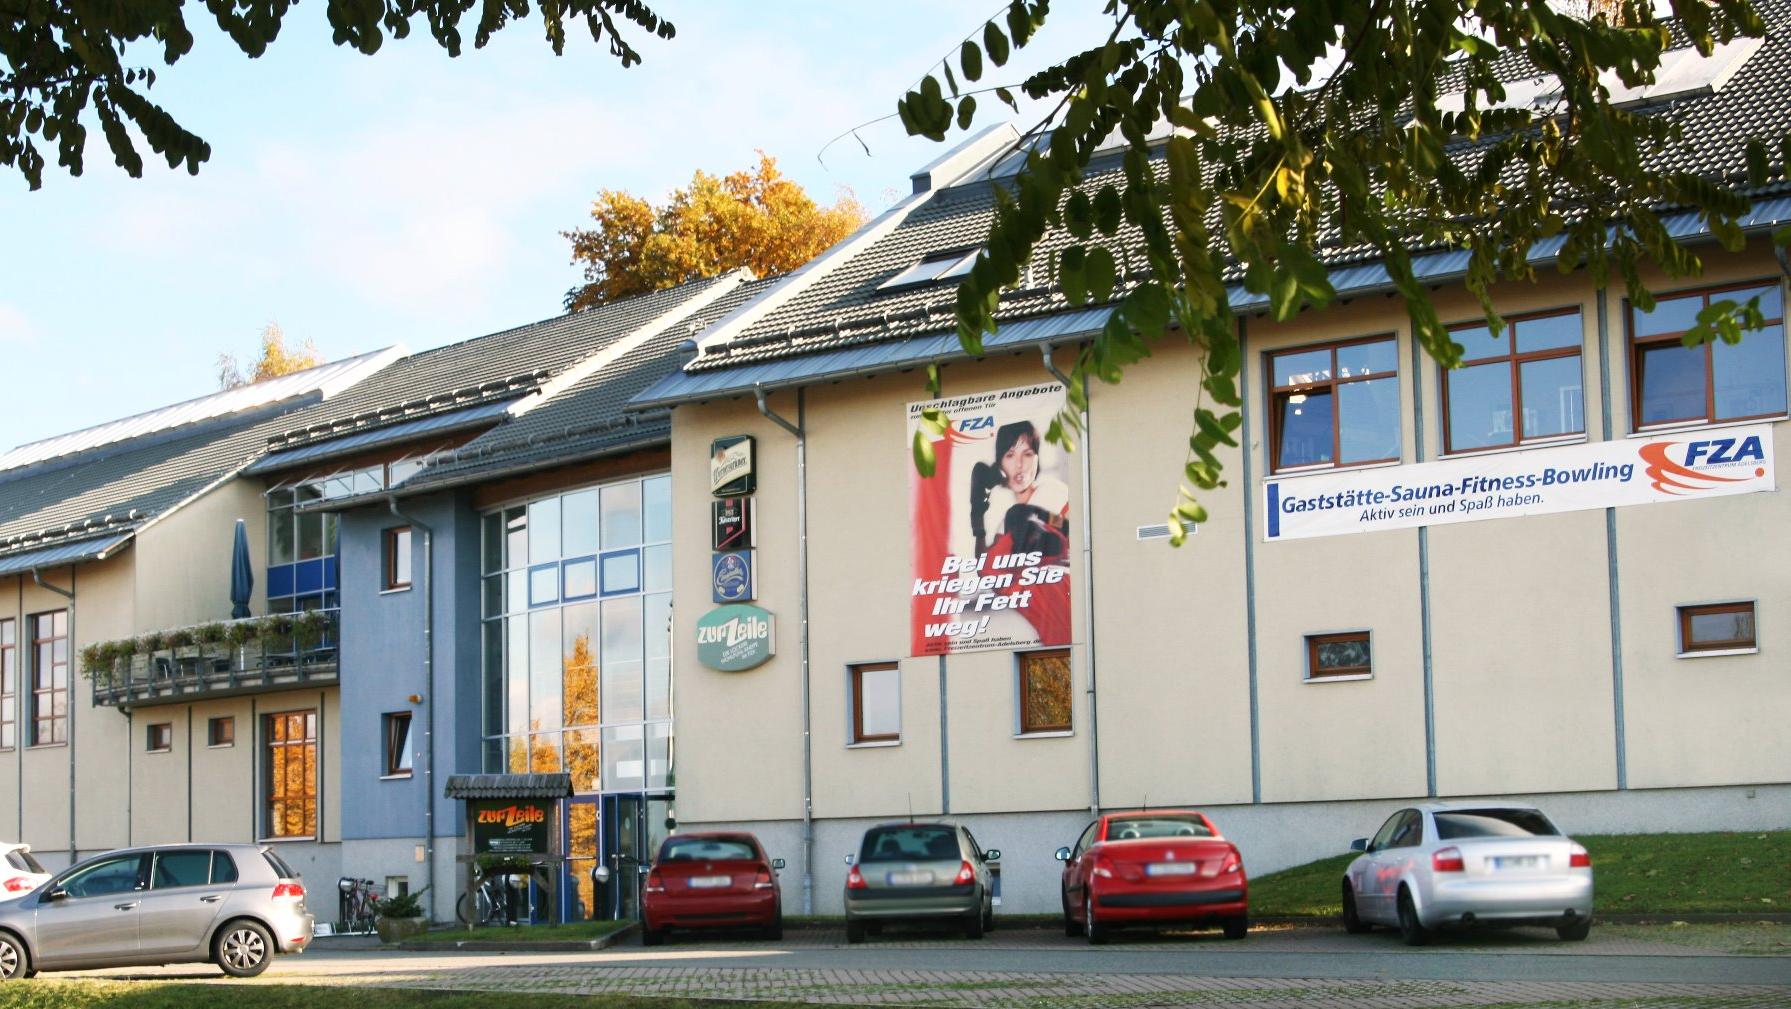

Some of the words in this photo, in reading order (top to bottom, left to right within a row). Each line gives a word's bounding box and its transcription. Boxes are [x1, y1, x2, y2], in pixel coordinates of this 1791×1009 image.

[910, 394, 996, 413] Unschlagbare
[999, 384, 1063, 401] Angebote
[959, 416, 995, 432] FZA
[1684, 435, 1765, 467] FZA
[1282, 462, 1634, 514] Gaststätte-Sauna-Fitness-Bowling
[1359, 507, 1395, 522] Aktiv
[1398, 506, 1425, 518] sein
[1429, 500, 1456, 515] und
[1459, 496, 1494, 514] Spaß
[1497, 493, 1545, 508] haben.
[941, 553, 988, 575] Bei
[992, 551, 1043, 570] uns
[912, 573, 1013, 596] kriegen
[1018, 567, 1065, 587] Sie
[932, 597, 971, 616] Ihr
[974, 590, 1032, 612] Fett
[697, 616, 768, 648] zurZeile
[924, 615, 990, 639] weg!
[478, 805, 544, 828] zurZeile
